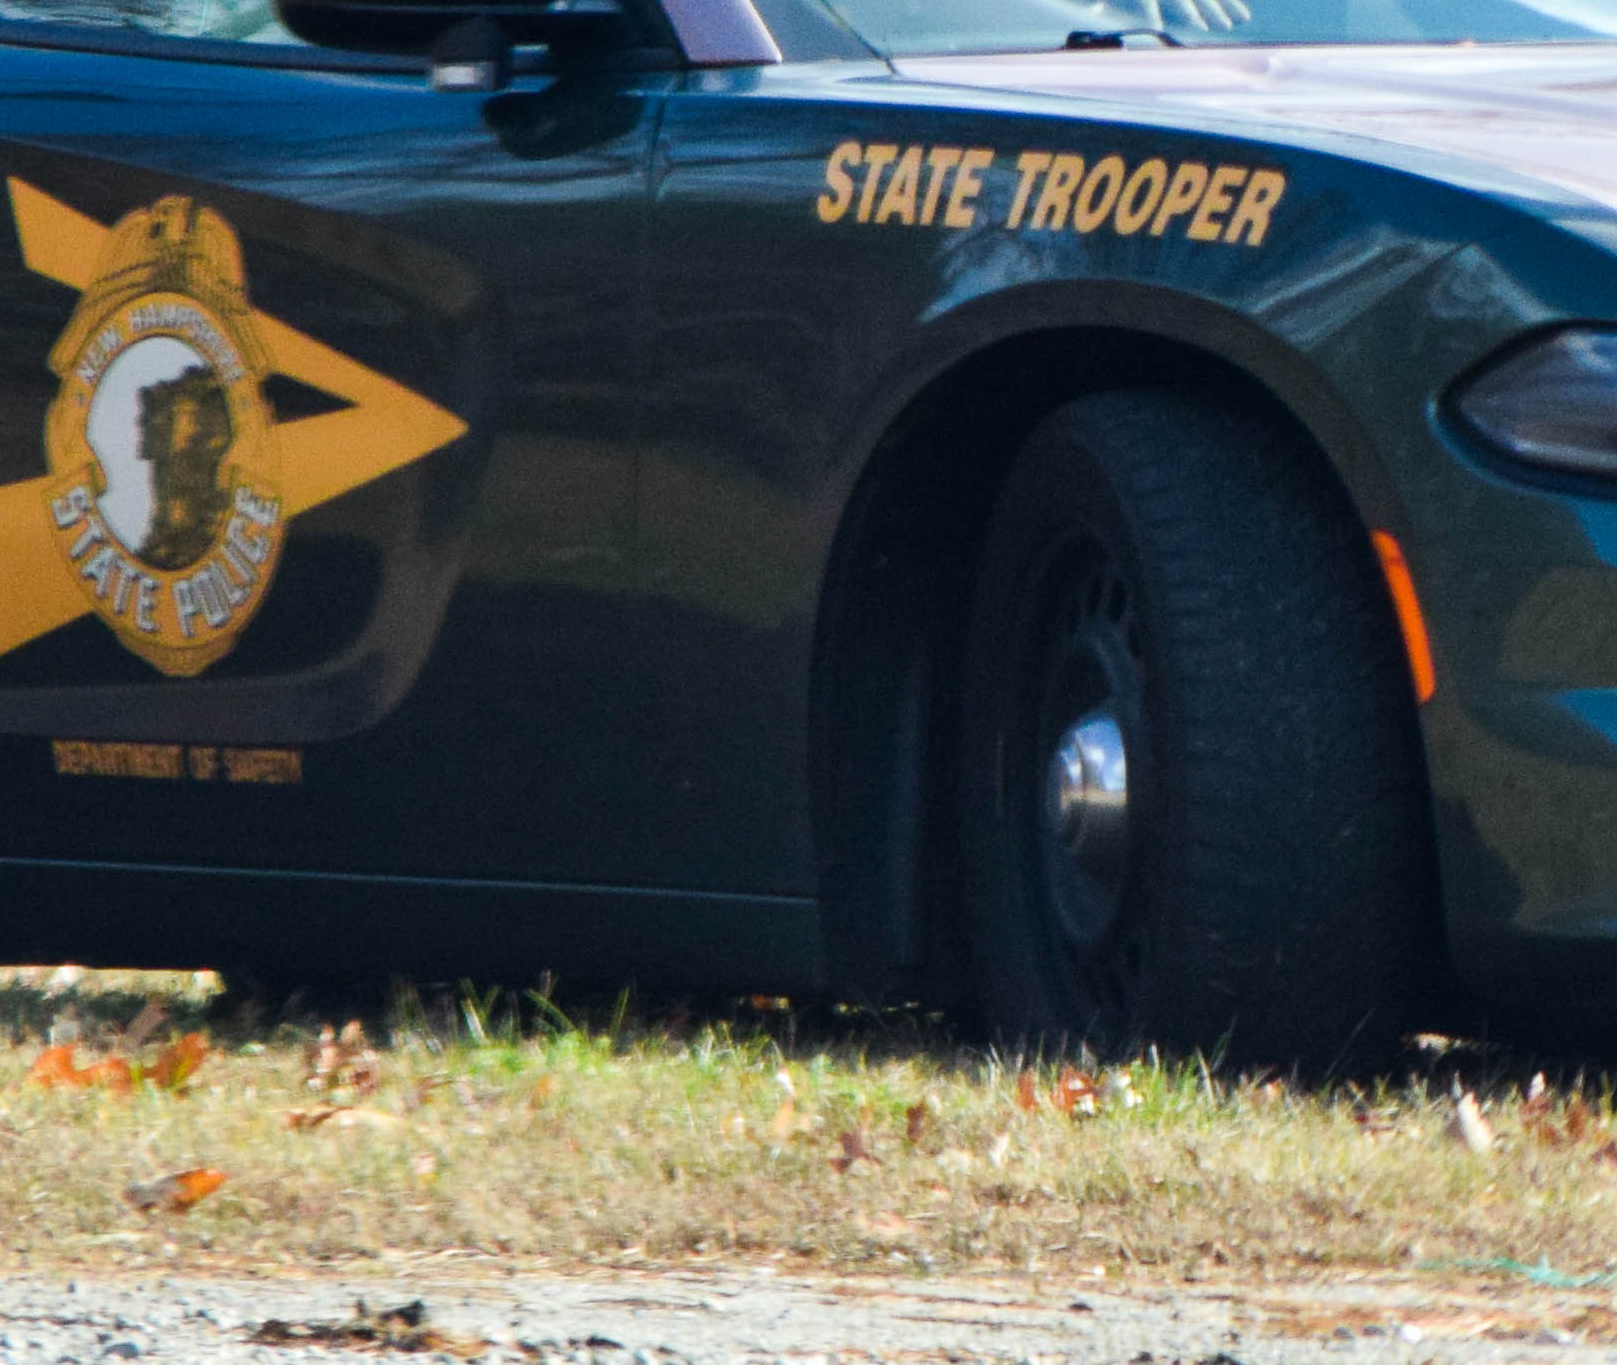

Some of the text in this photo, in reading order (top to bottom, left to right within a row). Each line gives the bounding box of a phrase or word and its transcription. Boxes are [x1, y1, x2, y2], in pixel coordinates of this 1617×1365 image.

[816, 140, 1286, 247] STATE TROOPER
[51, 485, 280, 636] STATE POLICE
